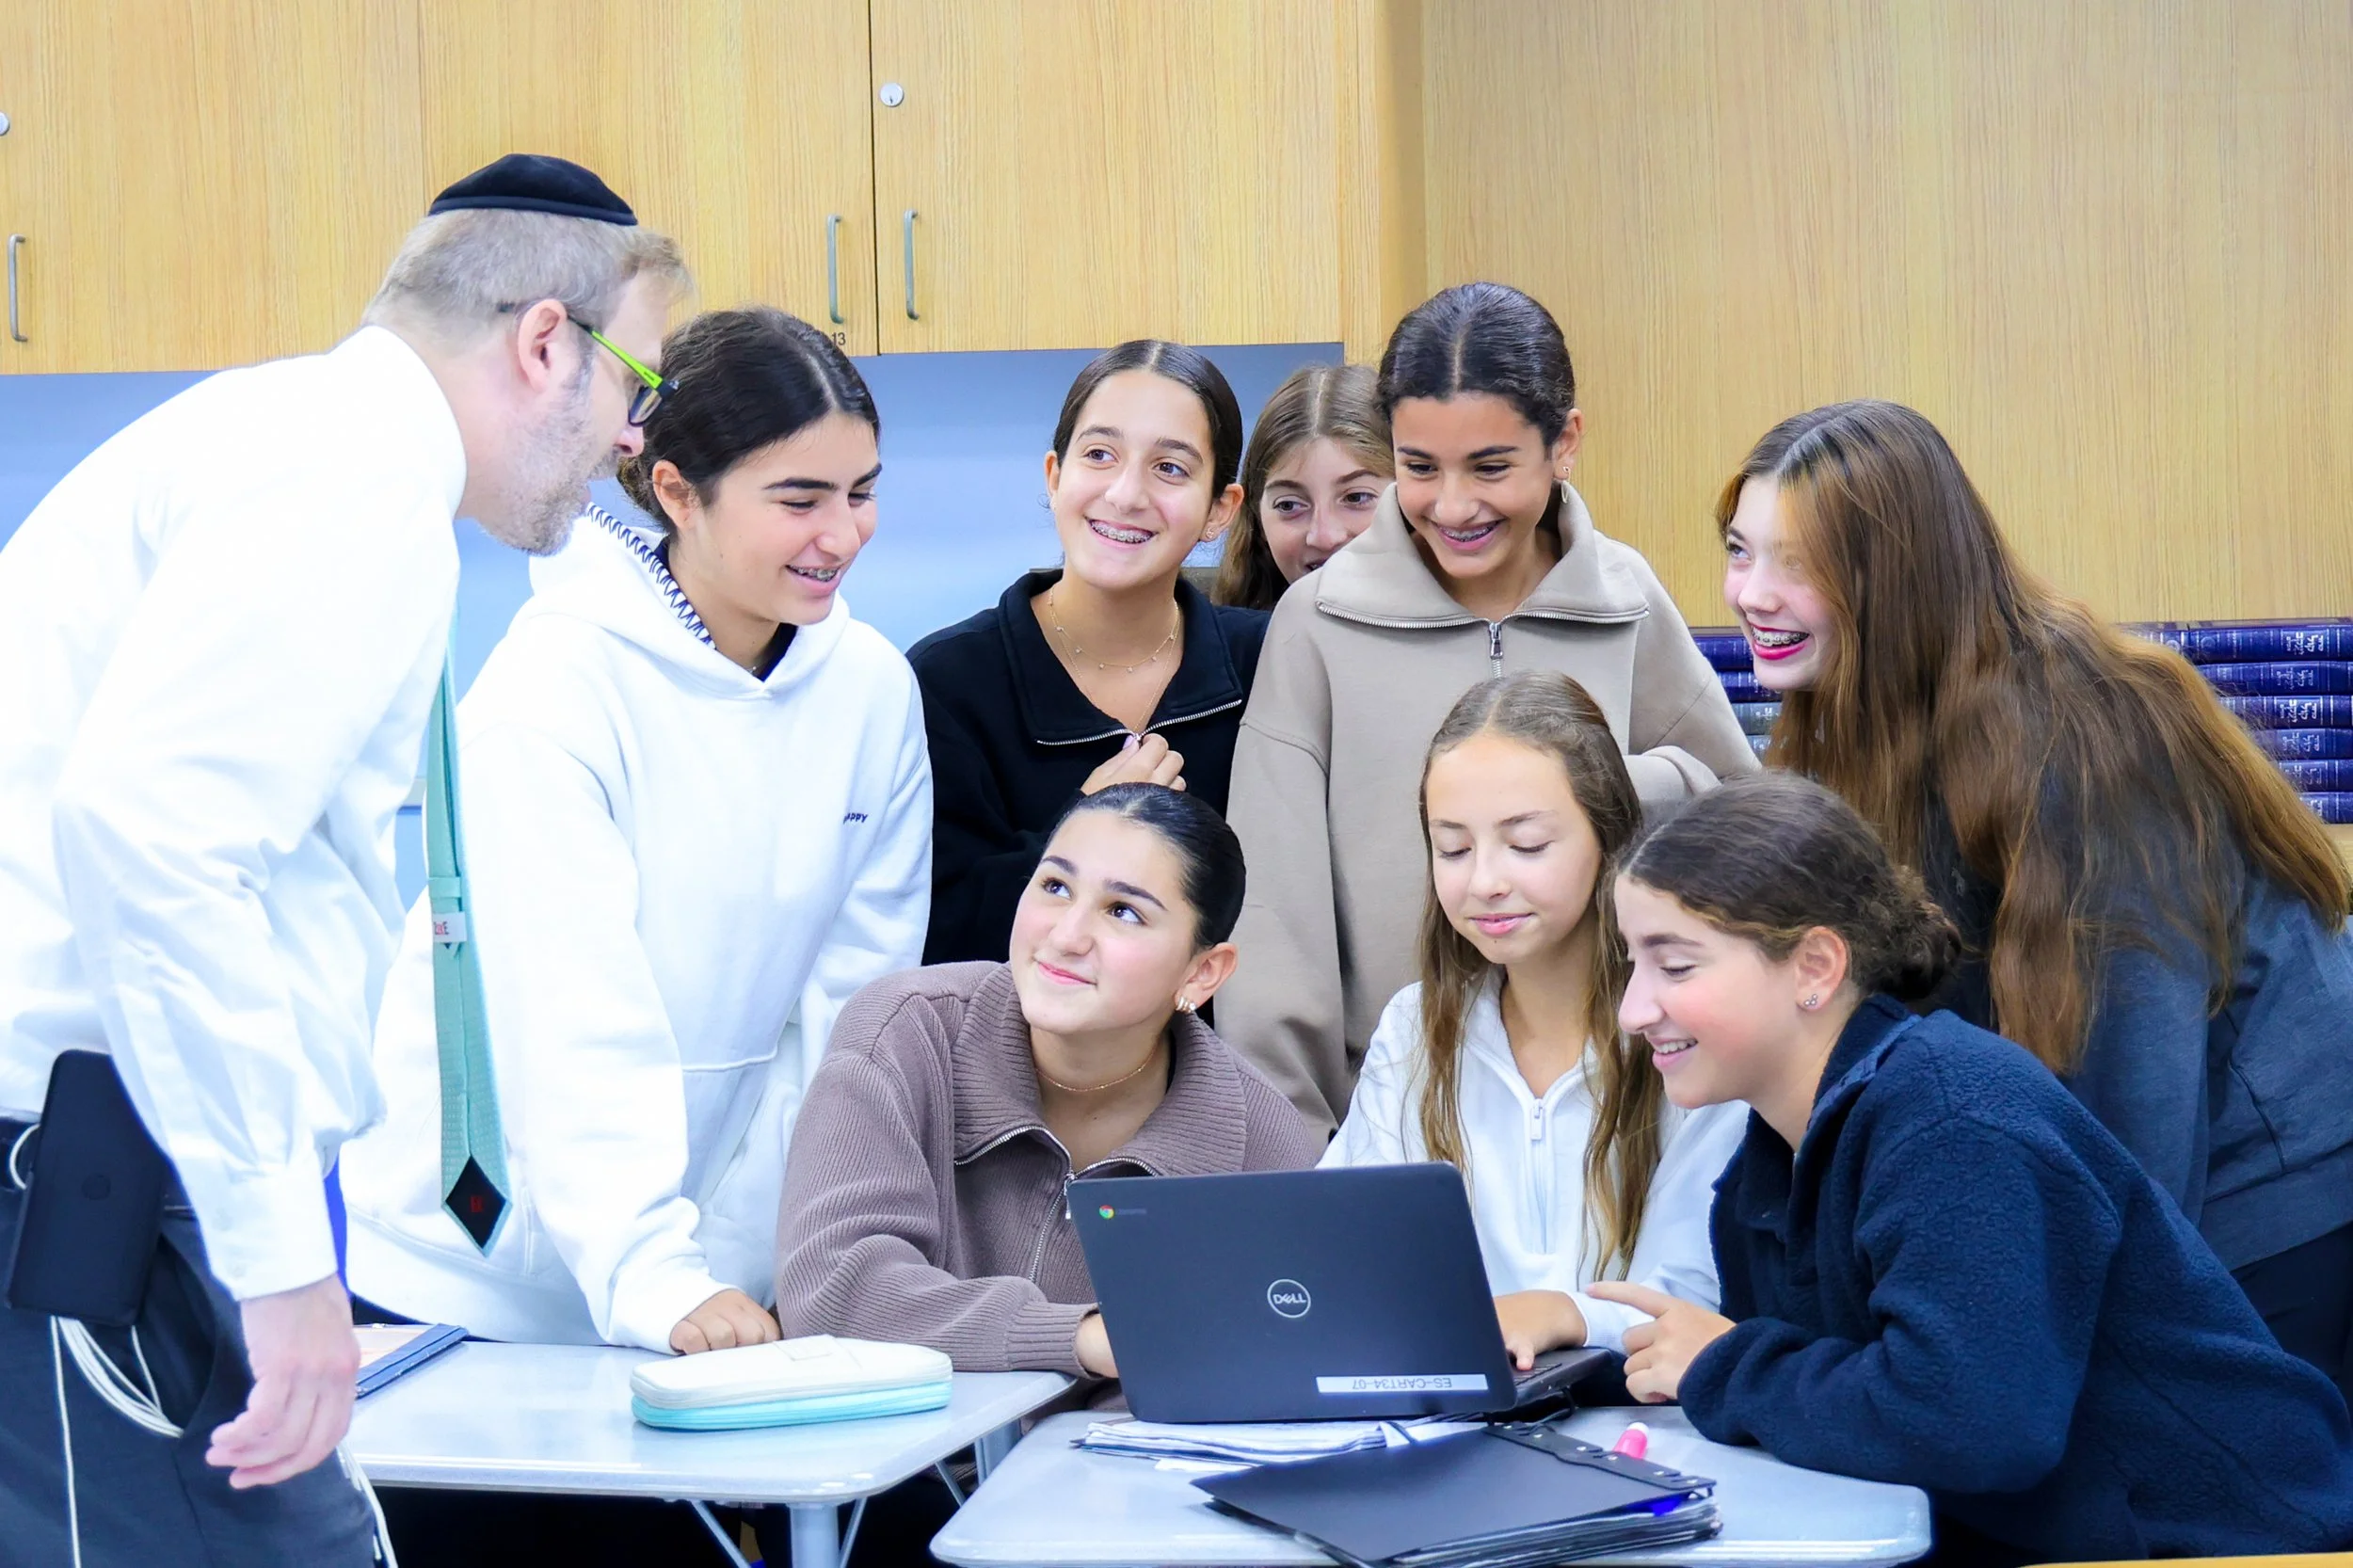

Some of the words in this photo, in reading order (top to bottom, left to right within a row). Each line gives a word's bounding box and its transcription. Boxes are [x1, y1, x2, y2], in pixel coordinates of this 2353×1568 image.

[832, 332, 846, 346] 13
[1273, 1293, 1306, 1304] DELL
[1353, 1377, 1452, 1390] ES-CART34-07
